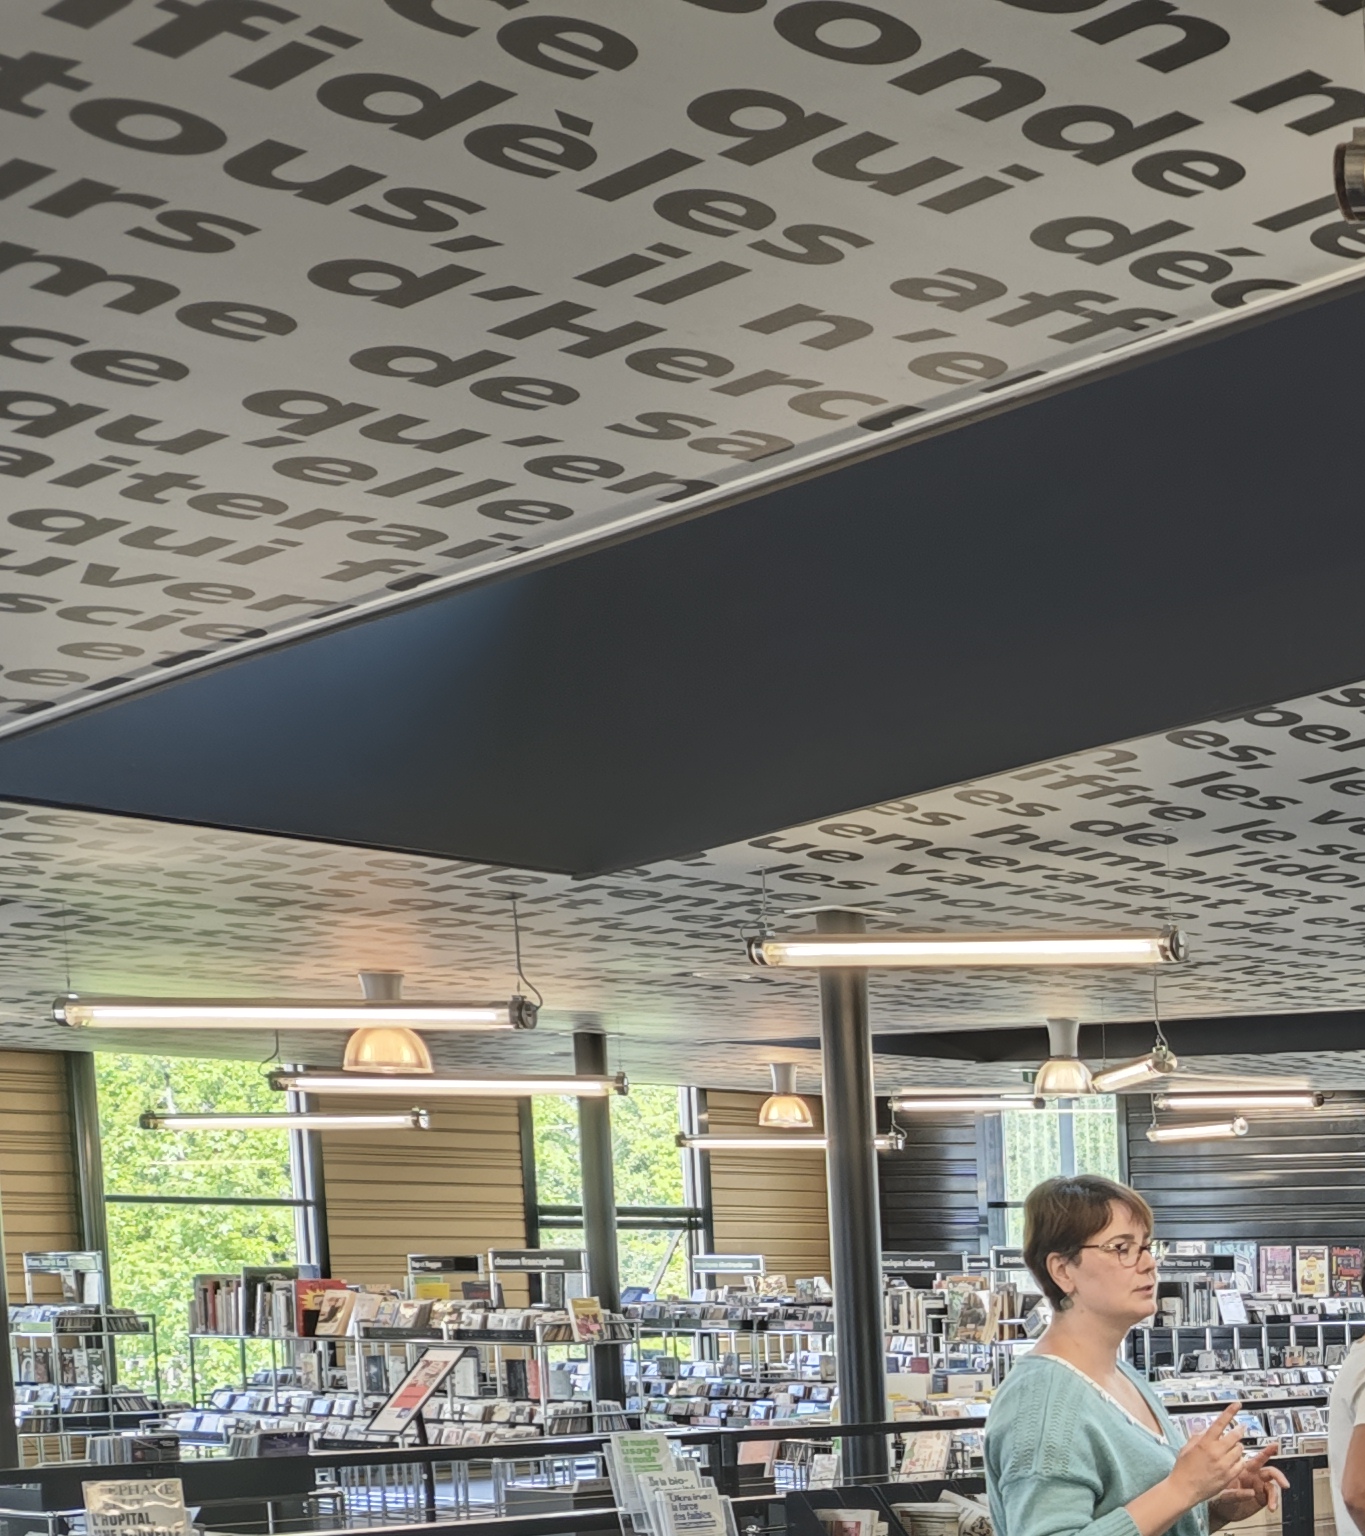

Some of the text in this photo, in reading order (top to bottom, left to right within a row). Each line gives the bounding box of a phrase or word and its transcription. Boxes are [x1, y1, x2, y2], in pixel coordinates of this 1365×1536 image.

[687, 87, 1044, 214] qui
[573, 242, 753, 305] il
[348, 345, 581, 411] de
[4, 507, 305, 566] qui
[1169, 770, 1302, 811] les
[1070, 819, 1180, 847] de
[1212, 819, 1298, 844] le
[746, 863, 880, 890] les
[971, 823, 1348, 905] humaines
[621, 1446, 660, 1457] usage
